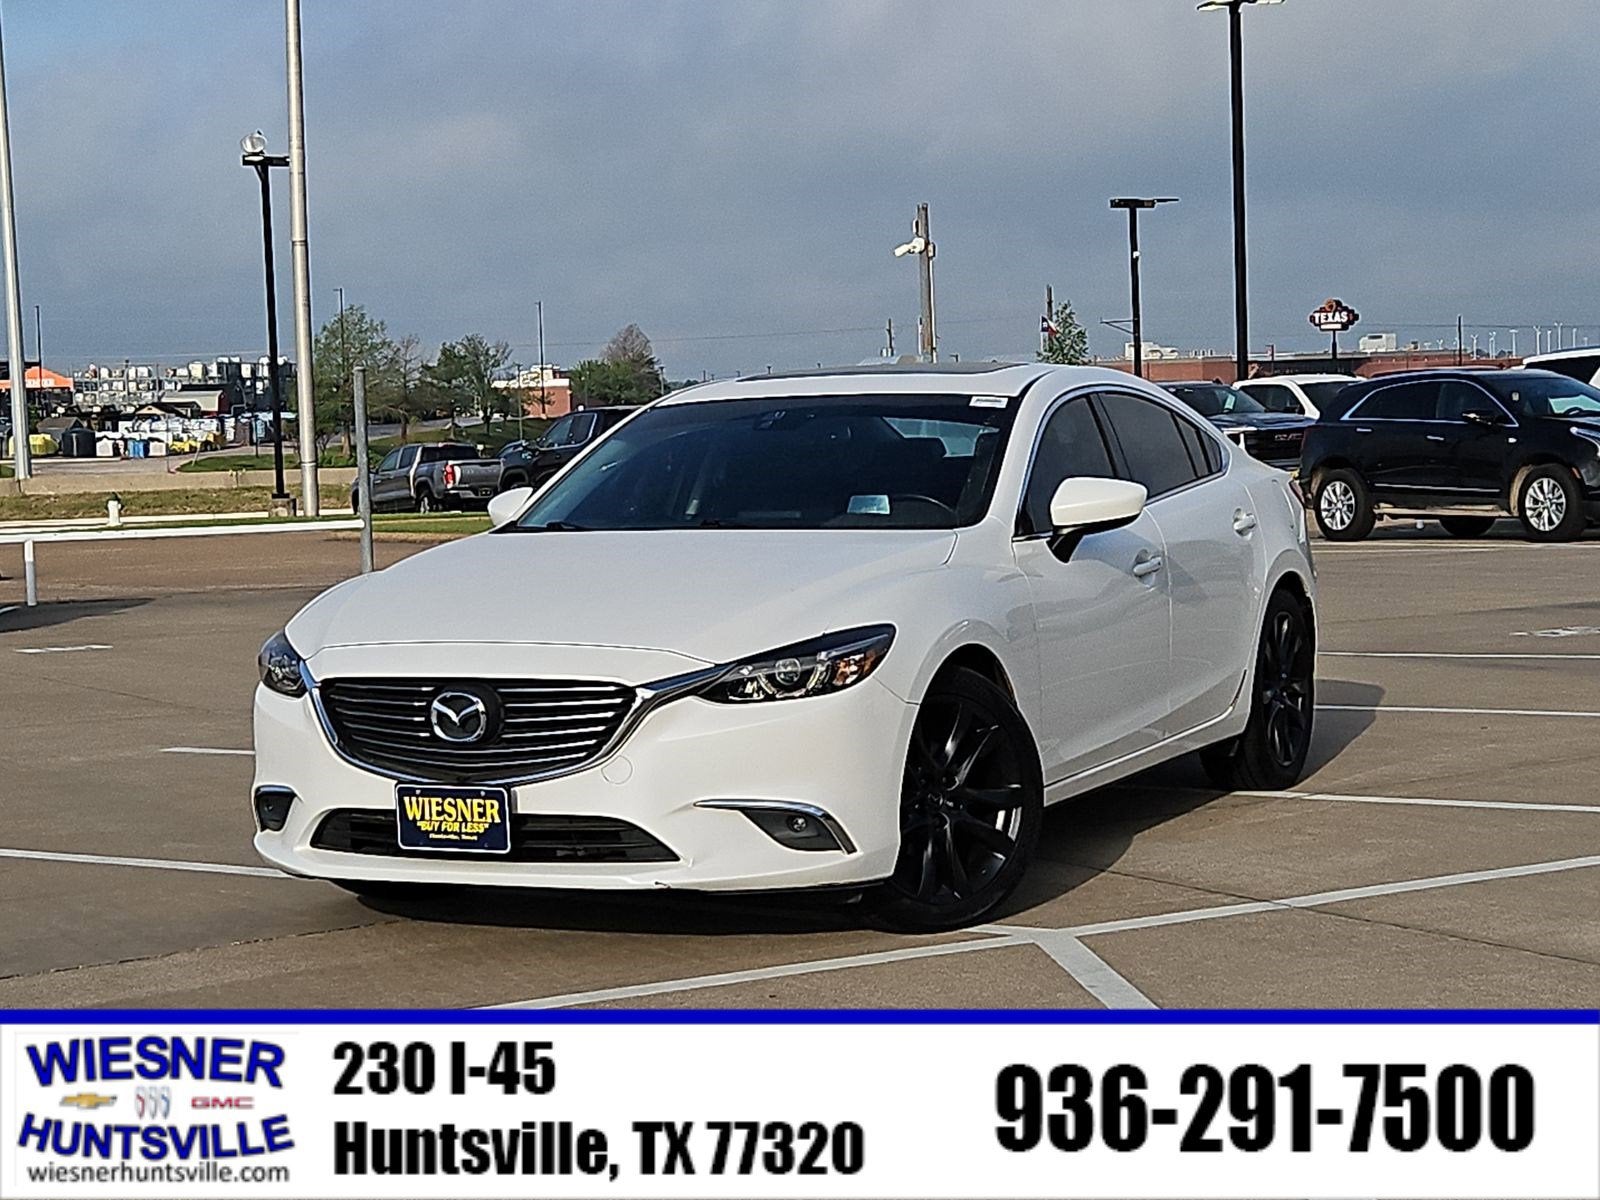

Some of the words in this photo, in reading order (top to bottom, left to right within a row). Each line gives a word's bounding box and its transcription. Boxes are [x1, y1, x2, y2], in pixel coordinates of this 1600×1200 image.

[1313, 311, 1349, 325] TEXAS
[403, 796, 501, 823] WIESNER
[441, 821, 460, 833] FOR
